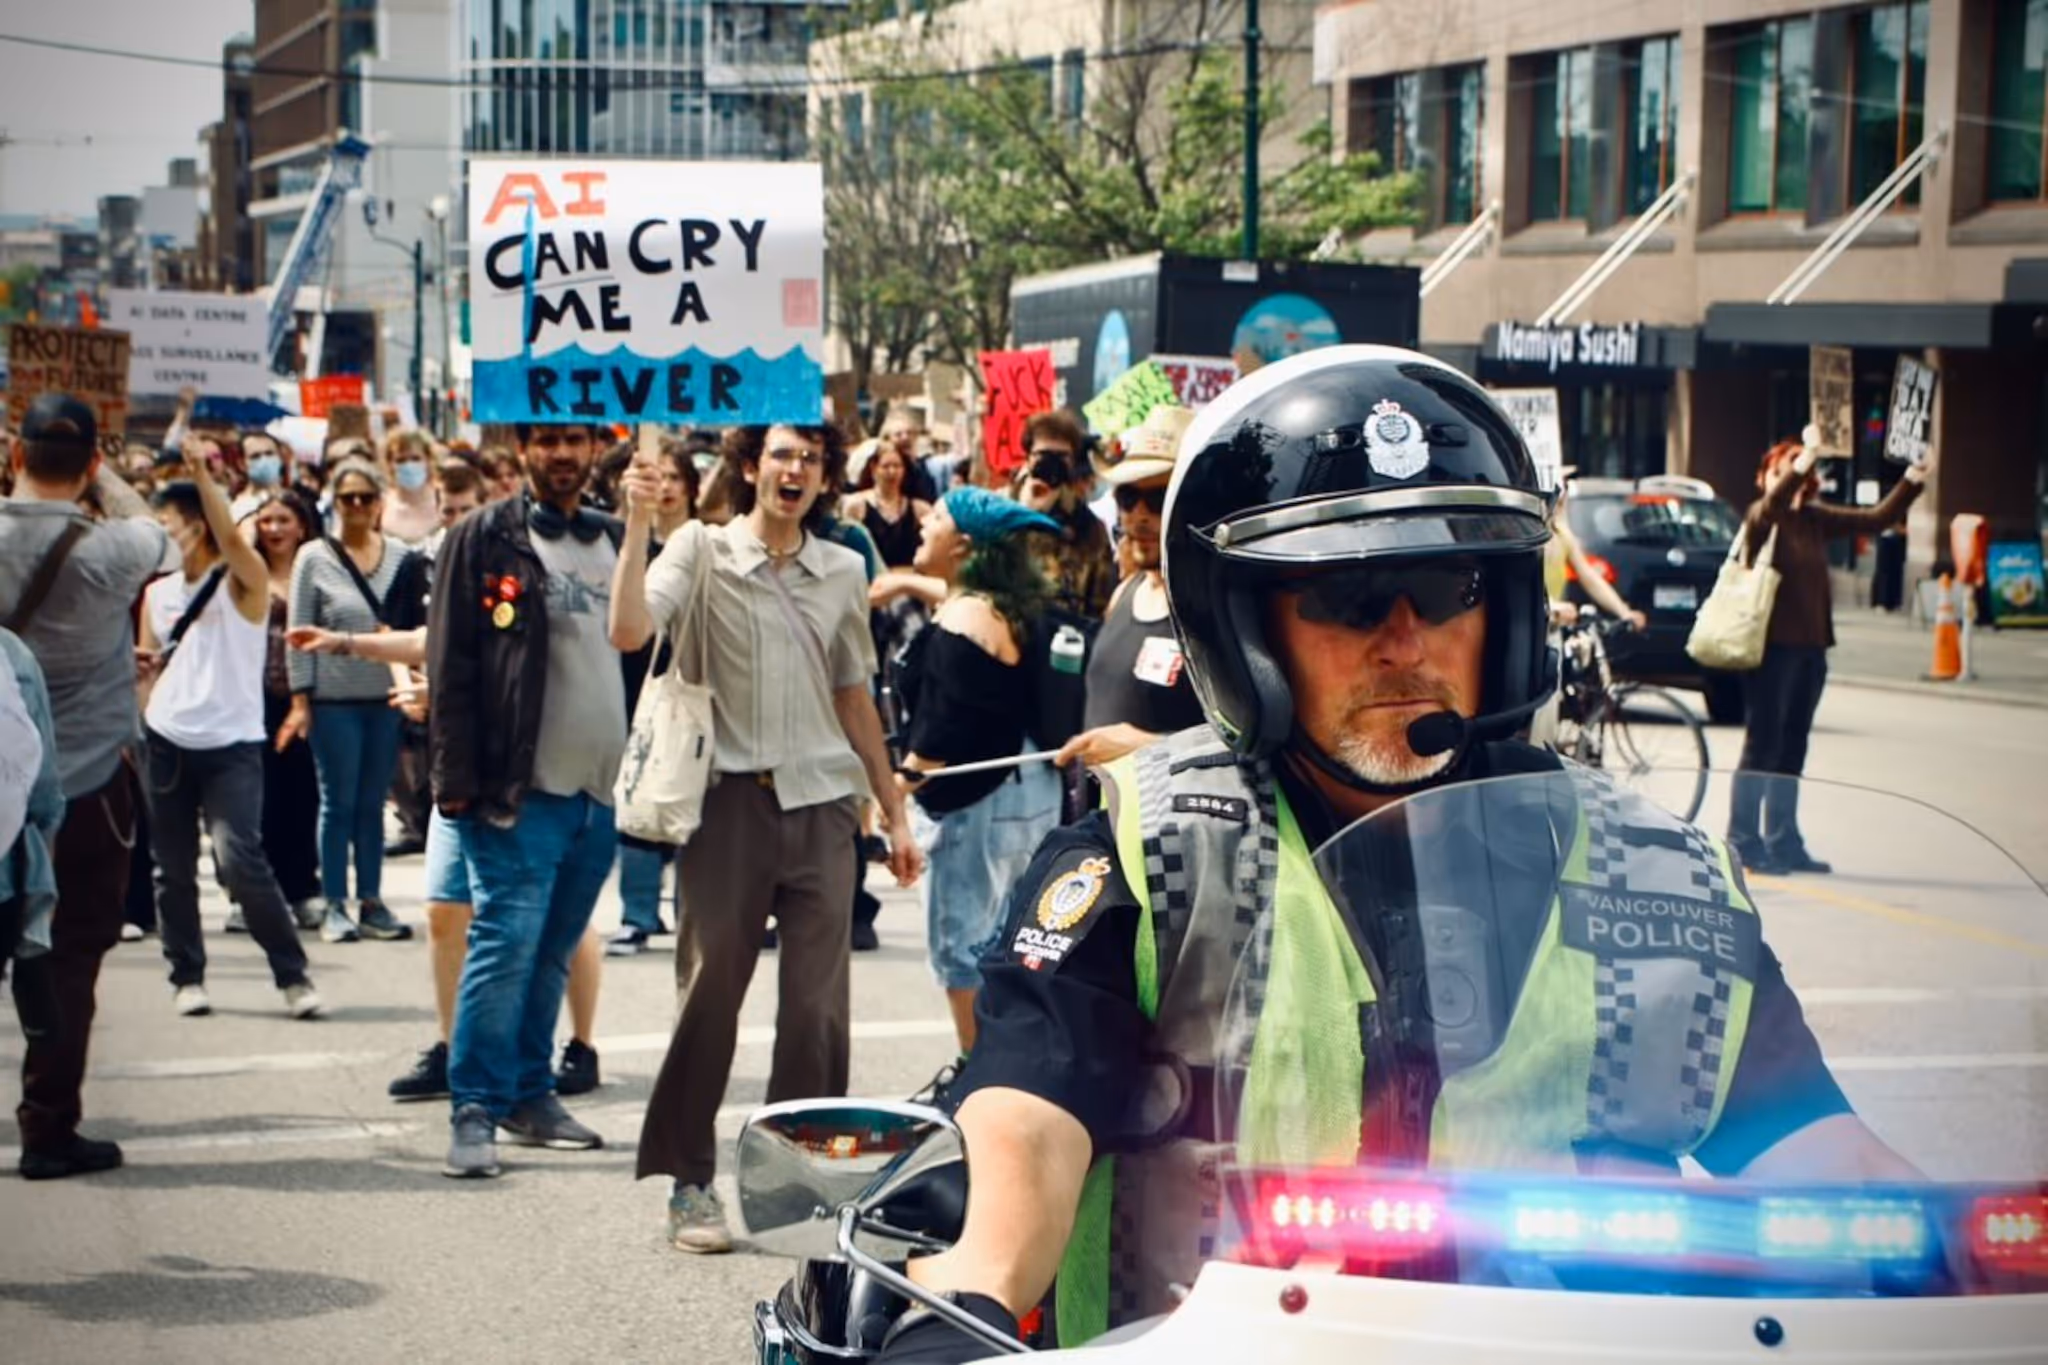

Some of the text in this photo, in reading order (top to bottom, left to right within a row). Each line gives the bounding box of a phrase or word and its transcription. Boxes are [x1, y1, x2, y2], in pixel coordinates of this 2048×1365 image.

[482, 171, 607, 224] AI
[485, 218, 766, 289] CAN CRY
[151, 307, 185, 319] DATA
[195, 309, 246, 323] CENTRE
[528, 281, 711, 344] ME A
[11, 324, 125, 370] PROTECT
[160, 346, 260, 364] SURVEILLANCE
[1498, 320, 1638, 373] Namiya Sushi
[153, 369, 207, 383] CENTRE
[526, 363, 742, 416] RIVER
[984, 354, 1053, 416] FUCK
[1587, 895, 1734, 930] VANCOUVER
[1017, 927, 1072, 952] POLICE
[1586, 915, 1737, 962] POLICE
